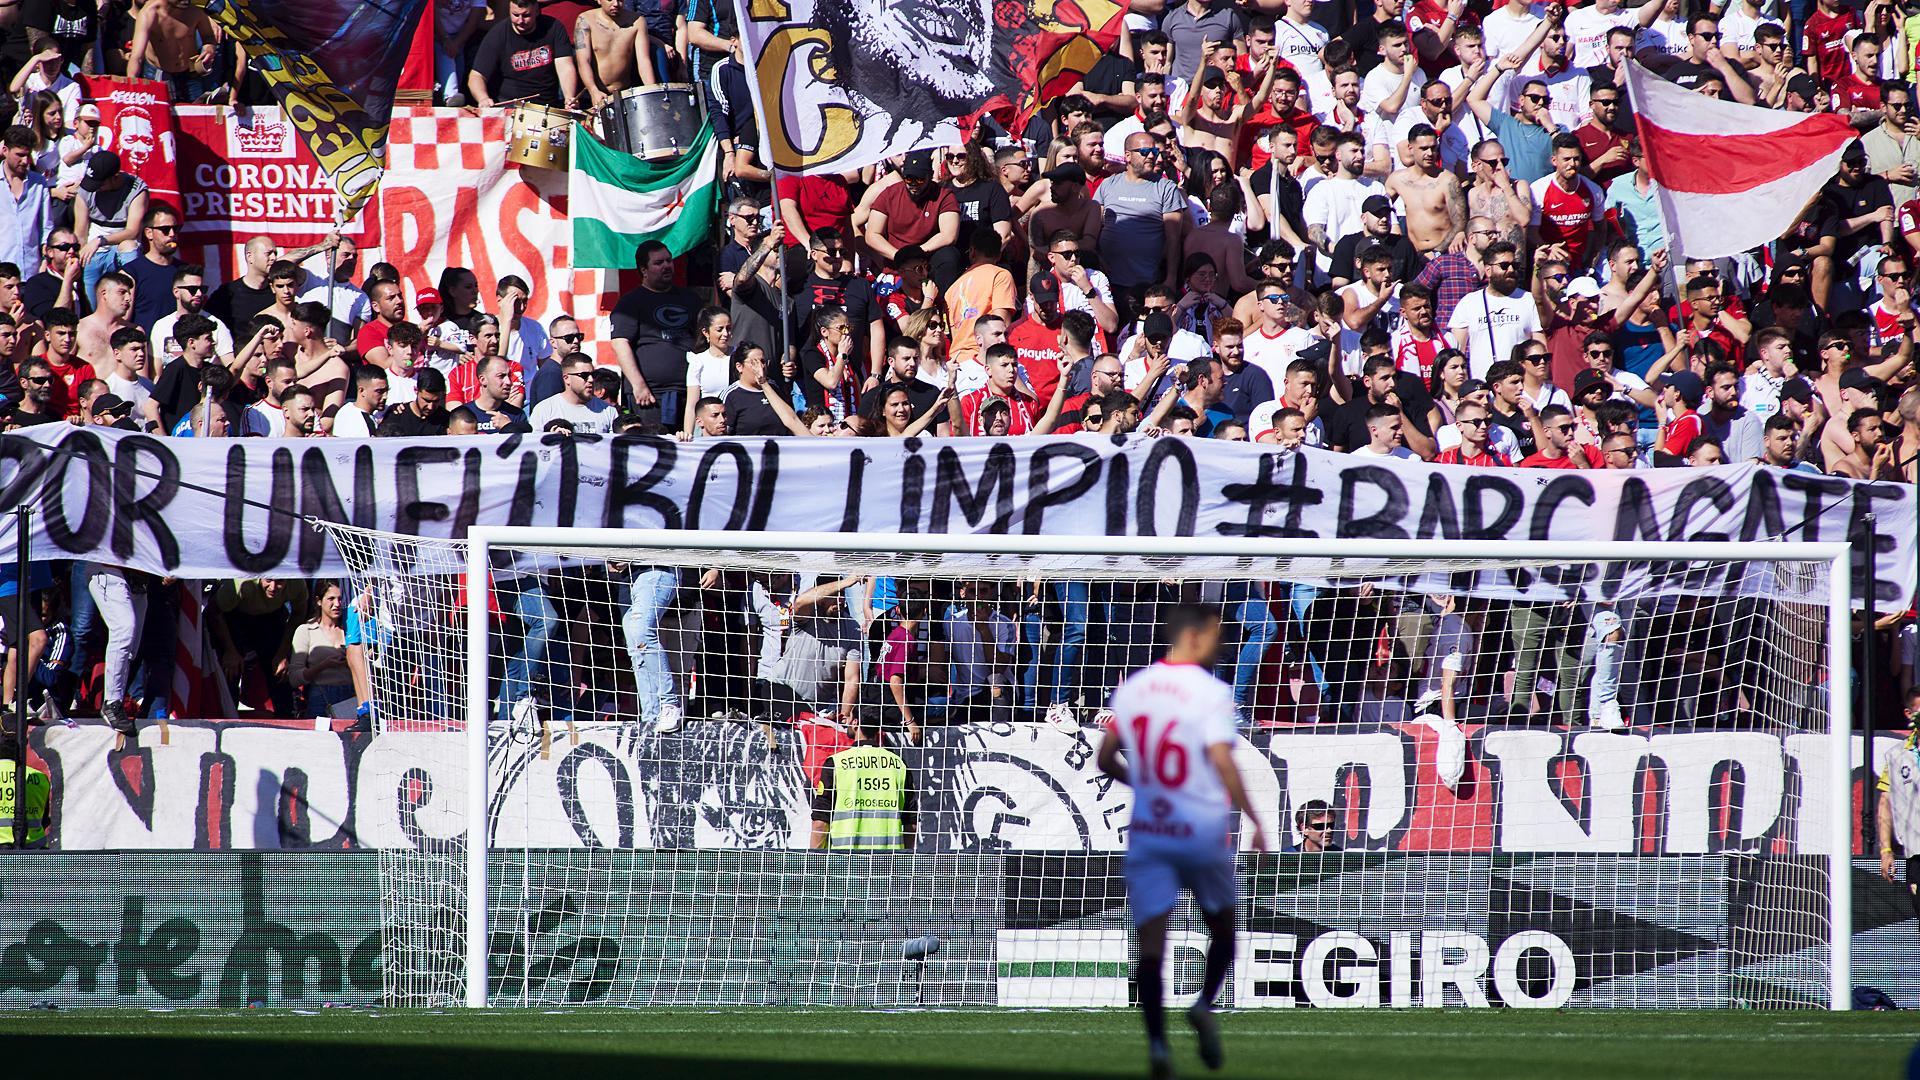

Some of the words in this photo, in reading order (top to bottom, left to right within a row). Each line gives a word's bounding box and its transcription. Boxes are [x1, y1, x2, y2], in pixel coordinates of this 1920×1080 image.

[195, 163, 332, 190] CORONA
[1478, 314, 1521, 325] HOLISTER
[223, 444, 376, 574] UN
[1130, 714, 1189, 791] 16
[840, 756, 902, 771] SEGURDAD
[856, 777, 891, 791] 1595
[854, 798, 898, 808] PROSEGU
[1162, 929, 1577, 1009] DEGIRO
